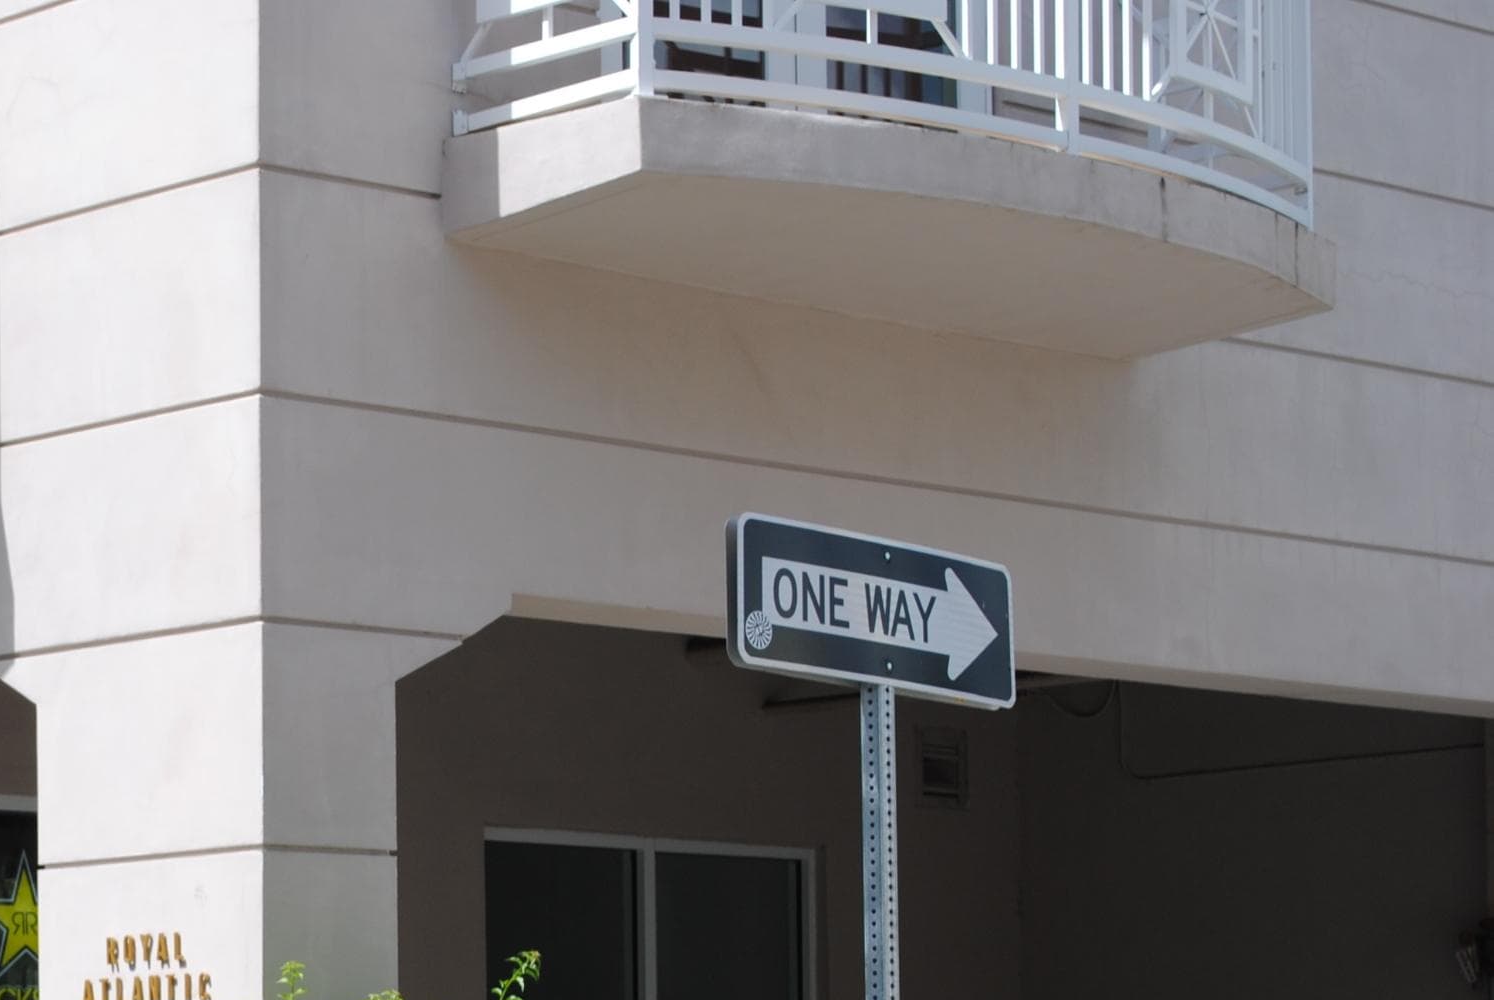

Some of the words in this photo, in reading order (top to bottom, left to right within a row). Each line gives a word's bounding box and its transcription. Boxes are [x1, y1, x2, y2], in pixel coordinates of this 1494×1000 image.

[773, 567, 850, 629] ONE
[865, 582, 937, 643] WAY
[106, 931, 186, 971] ROYAL
